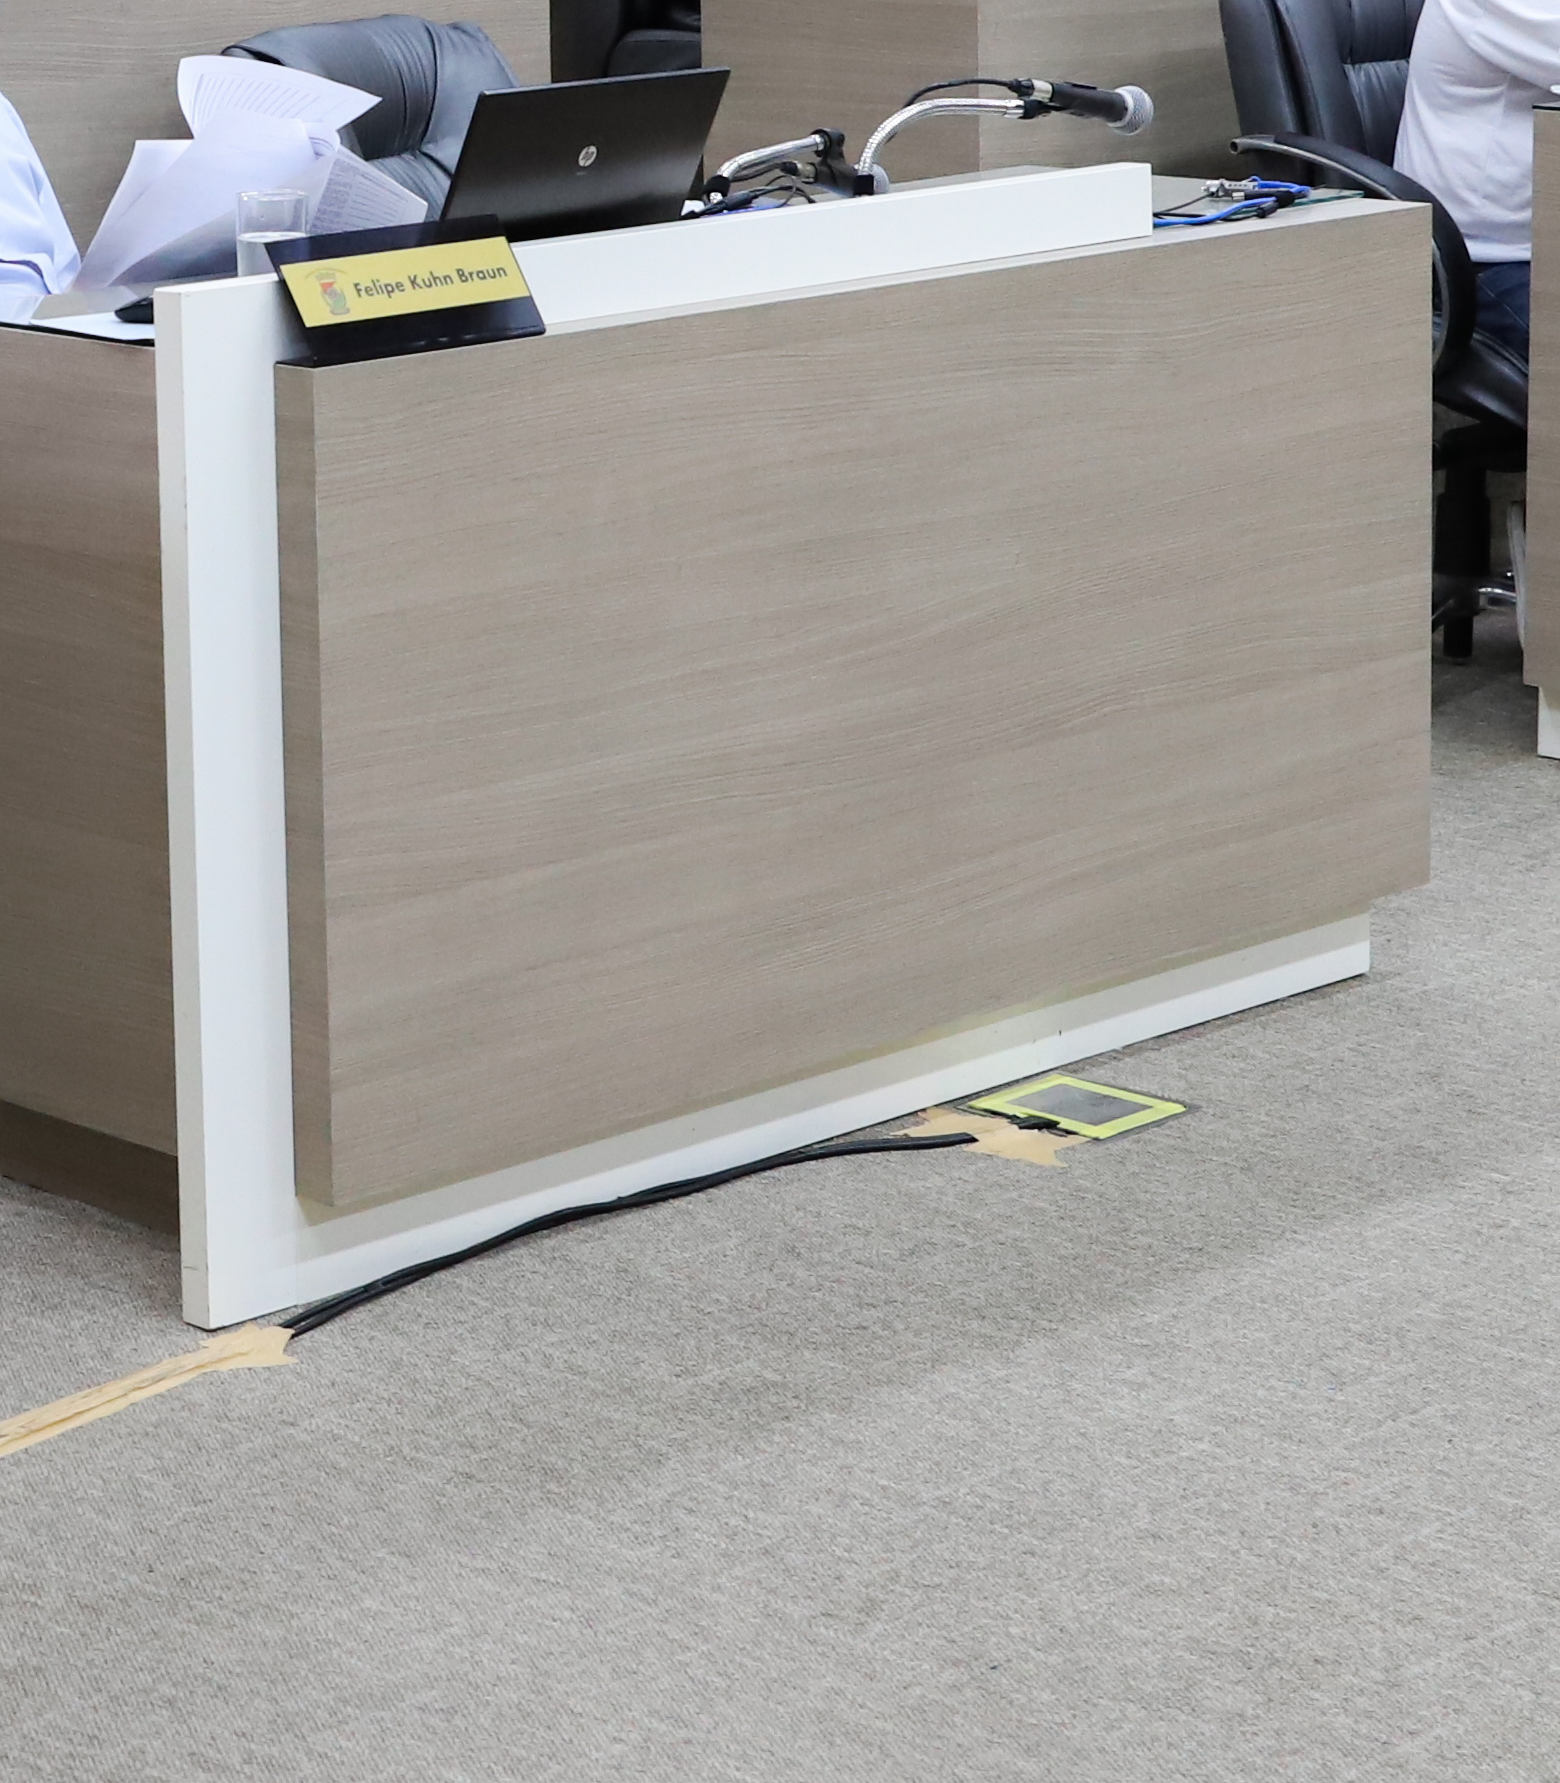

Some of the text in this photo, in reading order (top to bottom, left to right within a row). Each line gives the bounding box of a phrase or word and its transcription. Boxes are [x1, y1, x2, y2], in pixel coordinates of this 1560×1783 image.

[353, 266, 508, 298] Felipe Kuhn Braun
